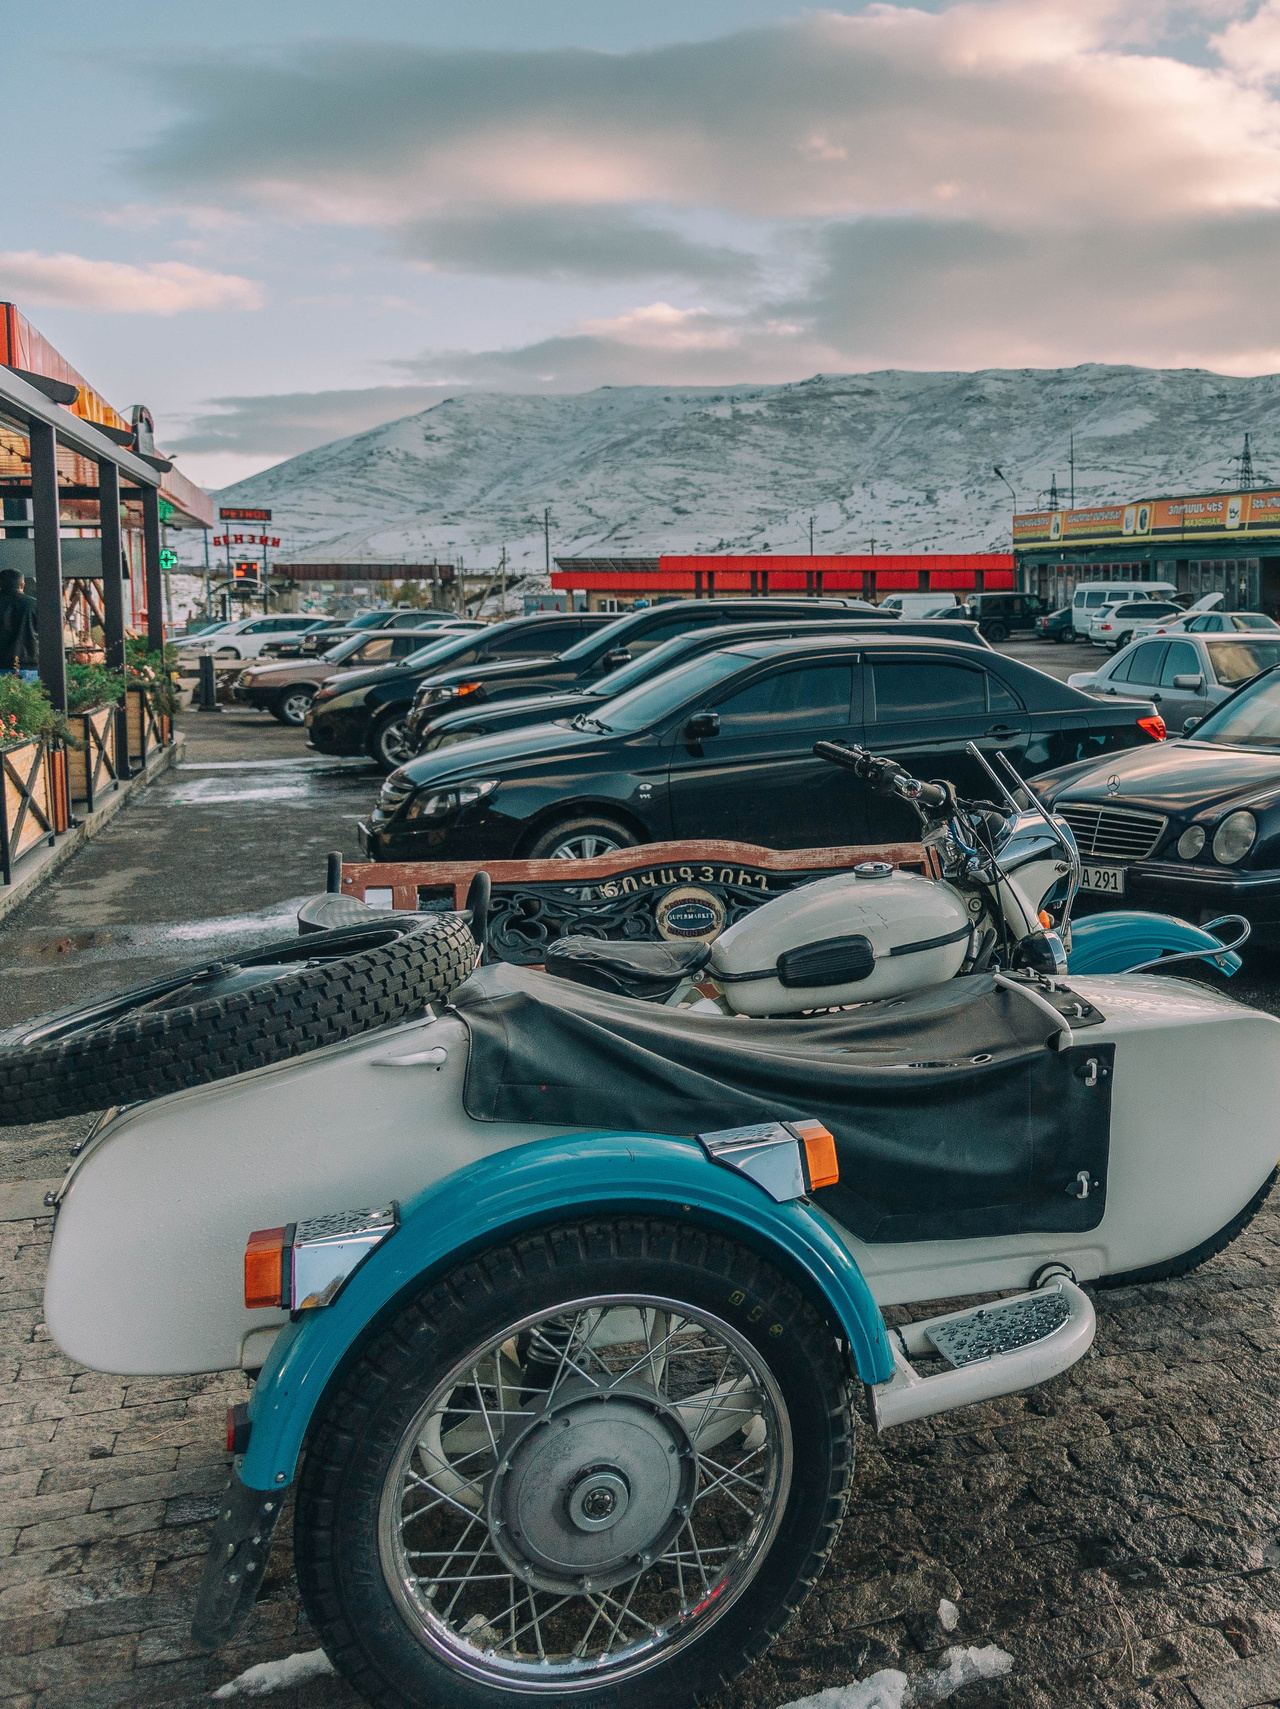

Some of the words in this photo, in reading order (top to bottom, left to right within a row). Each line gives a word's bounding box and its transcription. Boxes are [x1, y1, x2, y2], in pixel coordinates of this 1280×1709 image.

[221, 509, 268, 519] PETROL
[1180, 517, 1221, 527] МАЗОЧНАЯ
[213, 534, 281, 547] БЕНЗИН
[600, 866, 769, 899] ԾՈՎԱԳՅՈՒՂ
[1081, 868, 1091, 887] A
[1094, 870, 1119, 891] 291
[668, 912, 715, 921] SUPERMARKET
